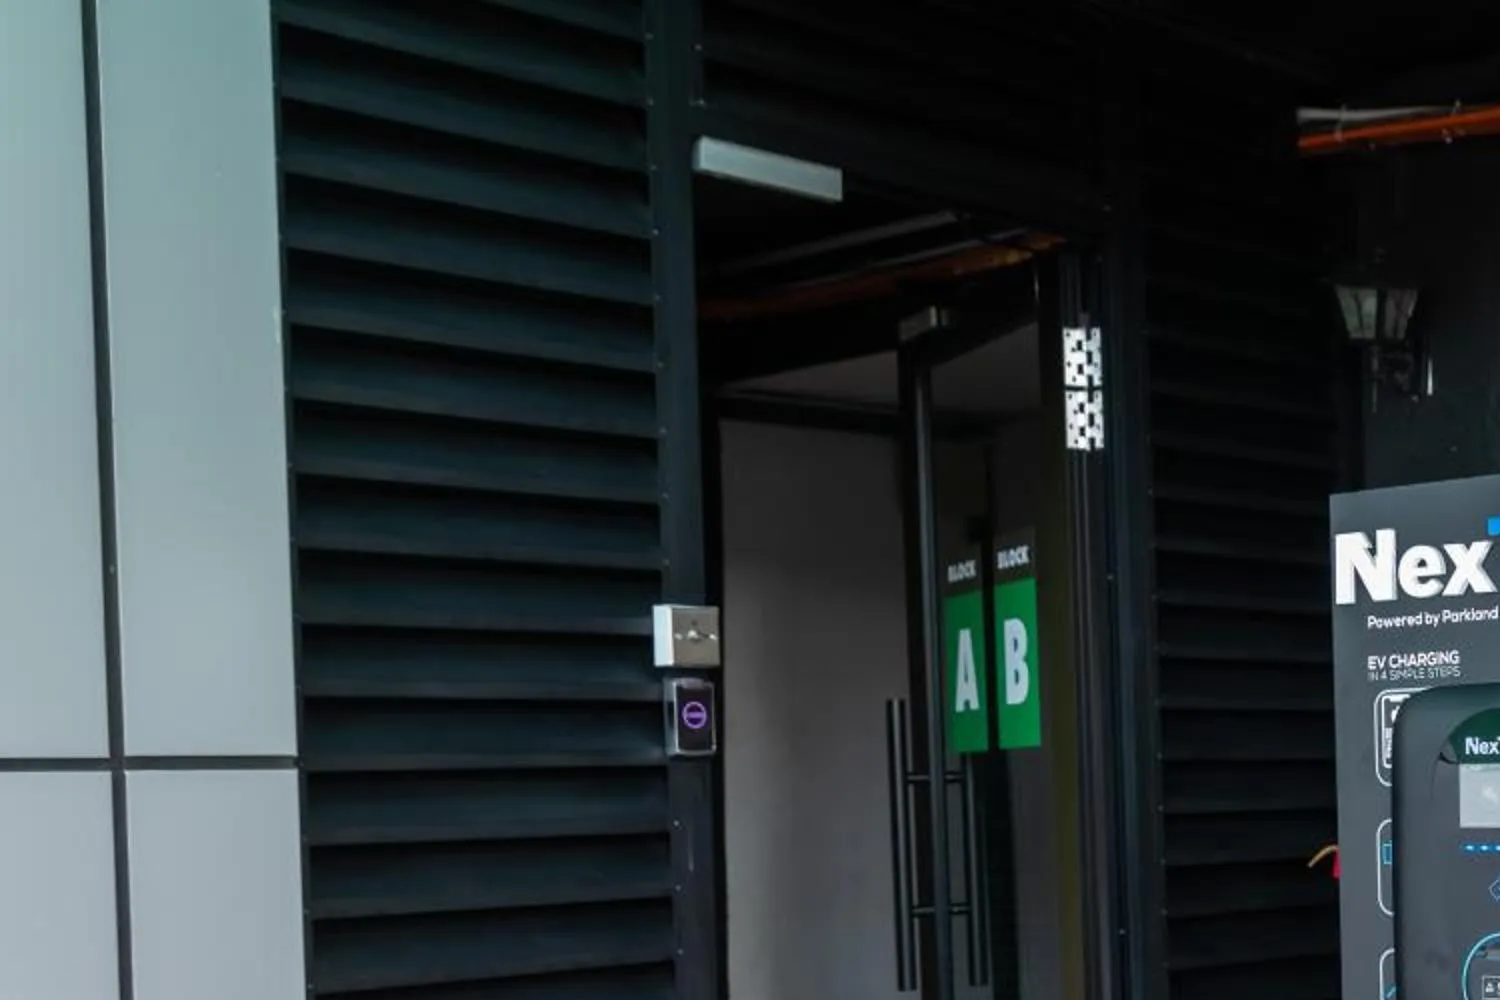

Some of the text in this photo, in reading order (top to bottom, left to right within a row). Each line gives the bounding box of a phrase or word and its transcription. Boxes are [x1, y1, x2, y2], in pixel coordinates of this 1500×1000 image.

[997, 544, 1029, 569] BLOCK
[947, 560, 977, 584] BLOCK
[1367, 604, 1499, 629] Powered by Parkland
[955, 628, 980, 713] A
[1003, 618, 1029, 705] B
[1367, 649, 1461, 671] EV CHARGING
[1389, 667, 1425, 681] SIMPLE
[1427, 665, 1461, 679] STEPS
